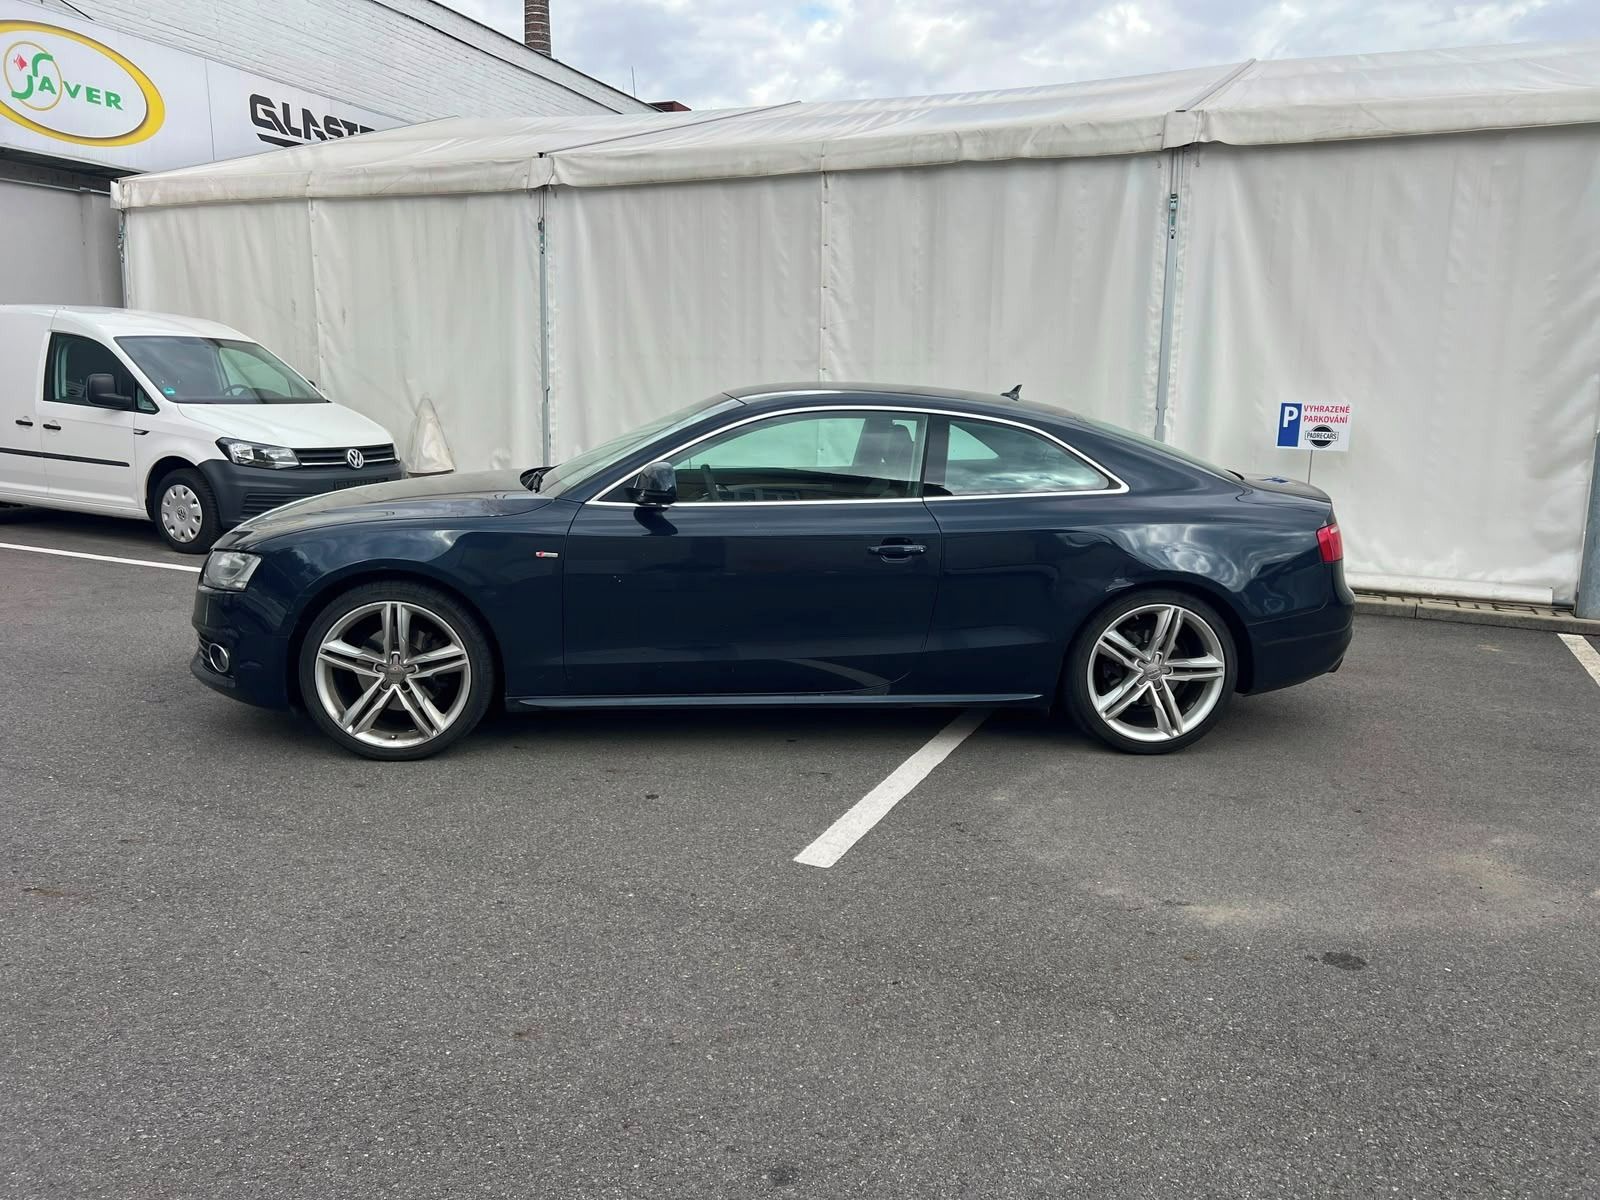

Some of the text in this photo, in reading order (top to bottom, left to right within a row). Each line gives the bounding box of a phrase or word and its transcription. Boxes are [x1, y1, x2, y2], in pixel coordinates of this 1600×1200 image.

[11, 53, 124, 110] SAVER
[249, 93, 376, 141] GLAST
[1283, 406, 1299, 428] P
[1303, 404, 1351, 413] VYHRAZENÉ
[1303, 414, 1348, 424] PARKOVÁNÍ
